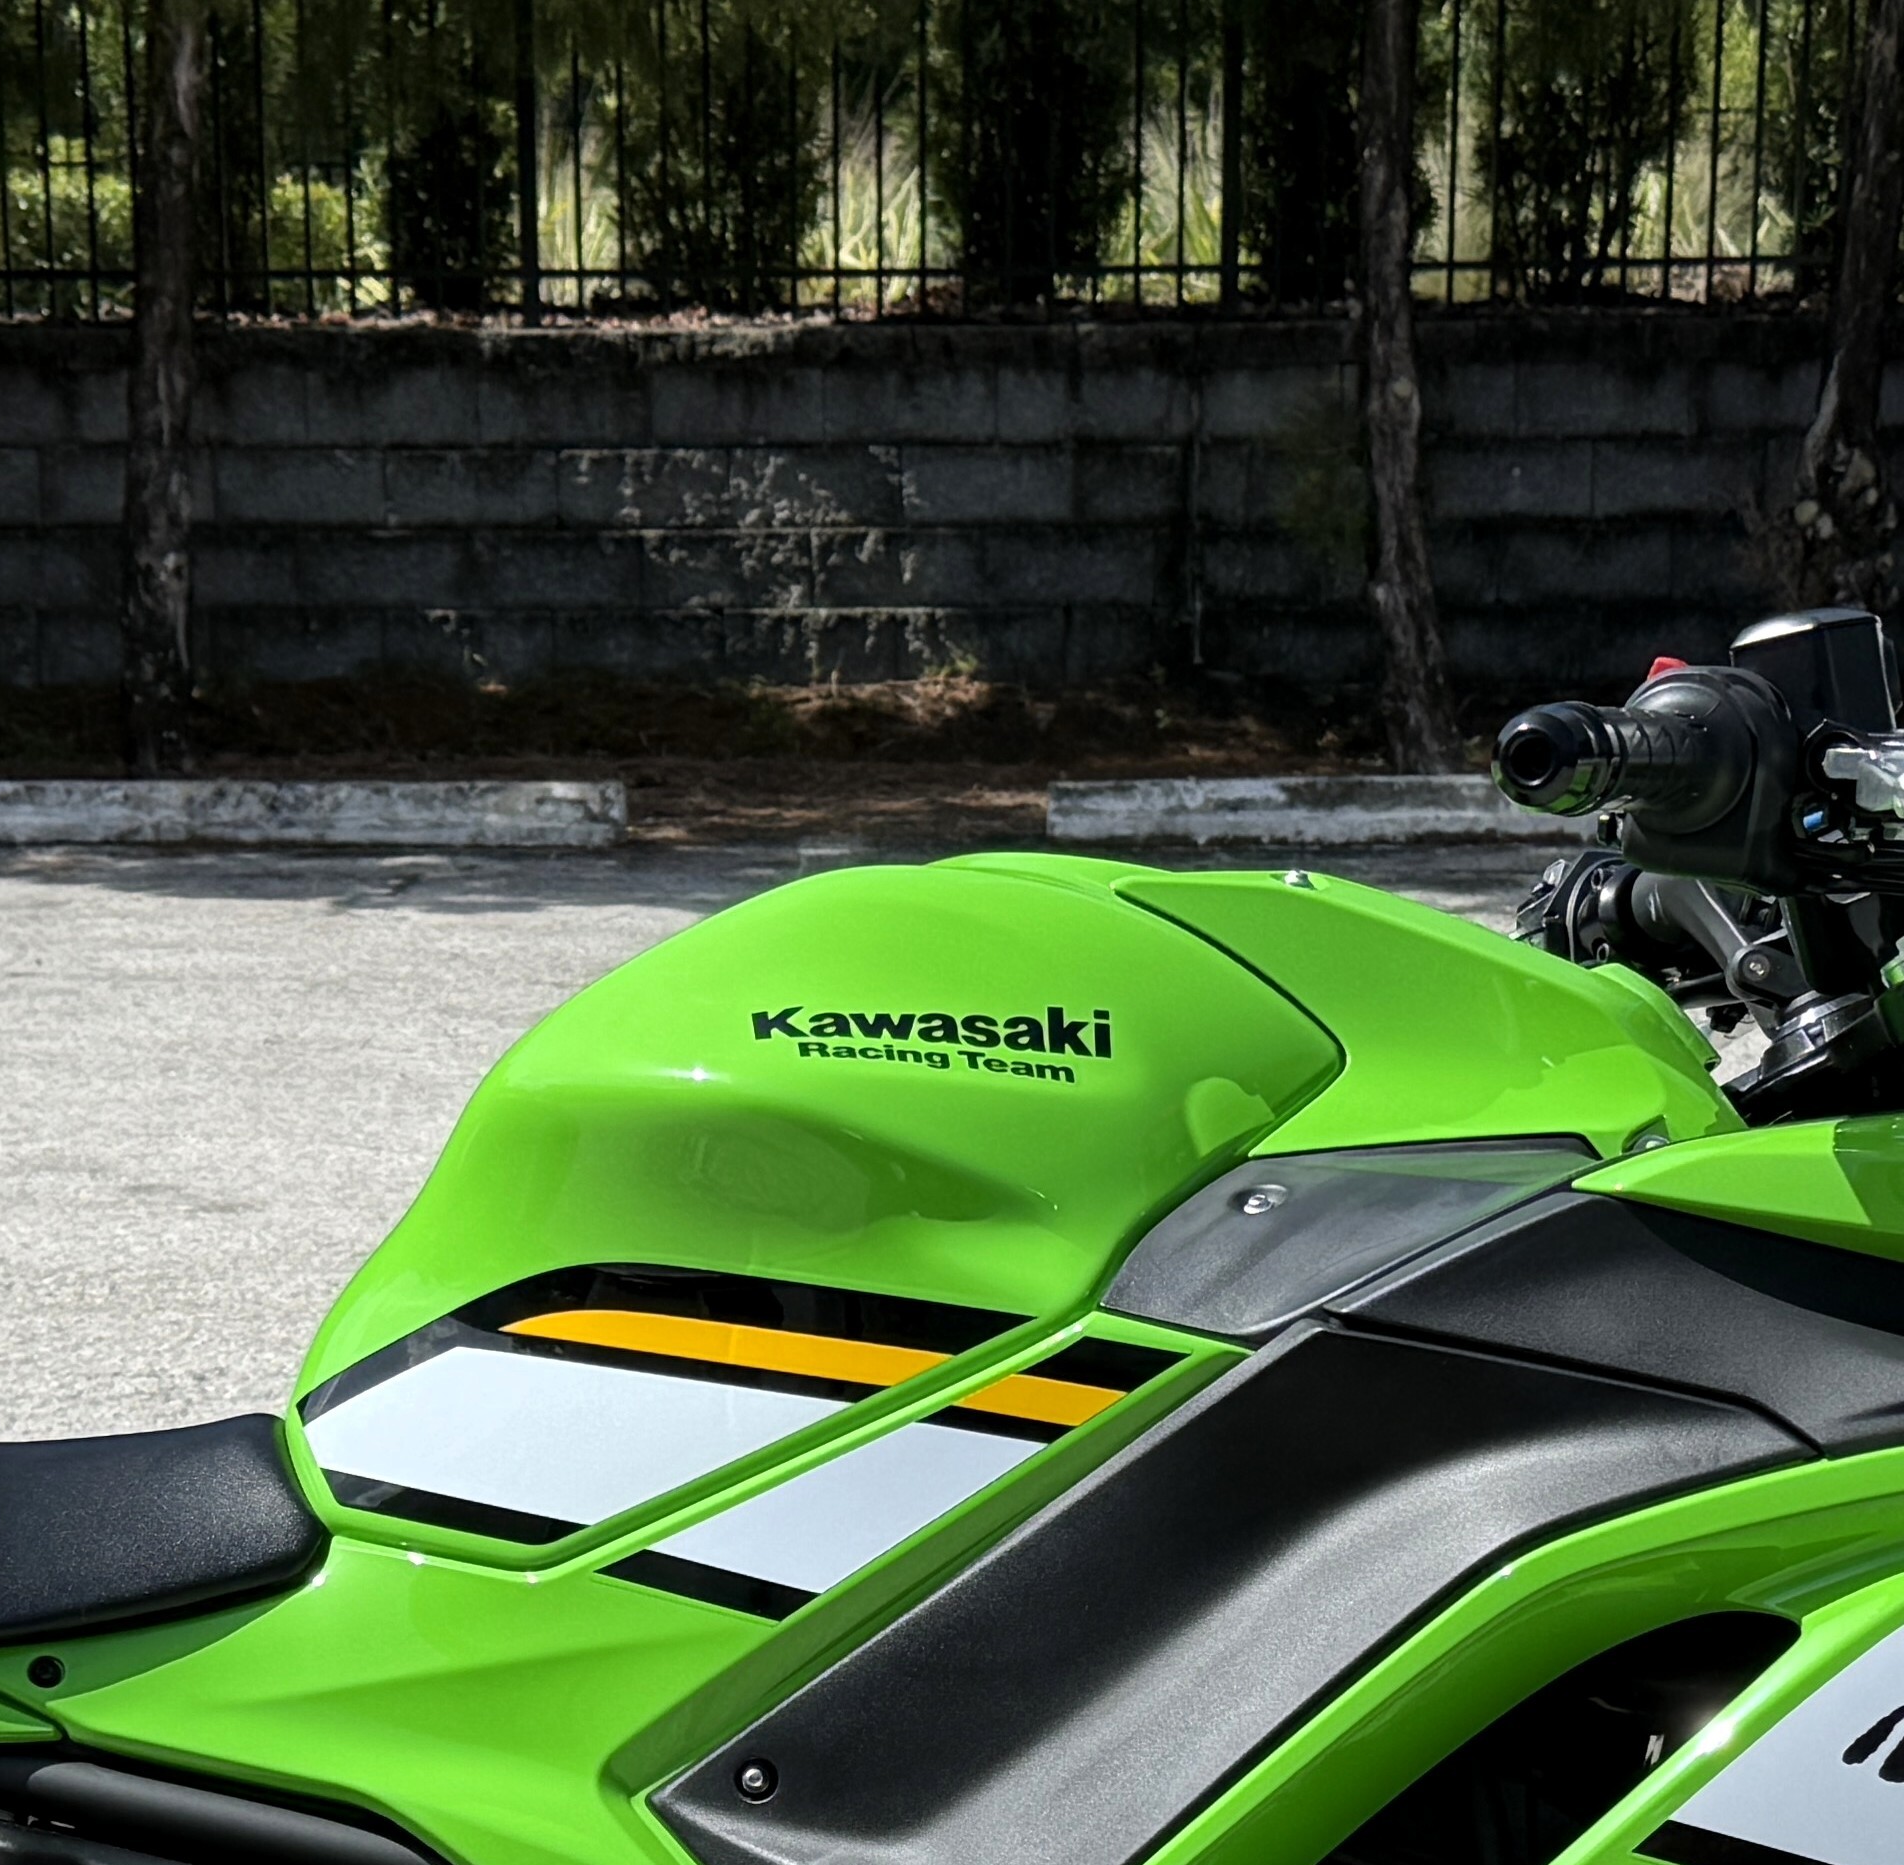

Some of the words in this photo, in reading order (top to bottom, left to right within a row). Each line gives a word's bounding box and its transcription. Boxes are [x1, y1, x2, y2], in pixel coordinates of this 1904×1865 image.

[752, 1005, 1112, 1058] Kawasaki
[797, 1042, 950, 1069] Racing
[957, 1050, 1075, 1083] Team
